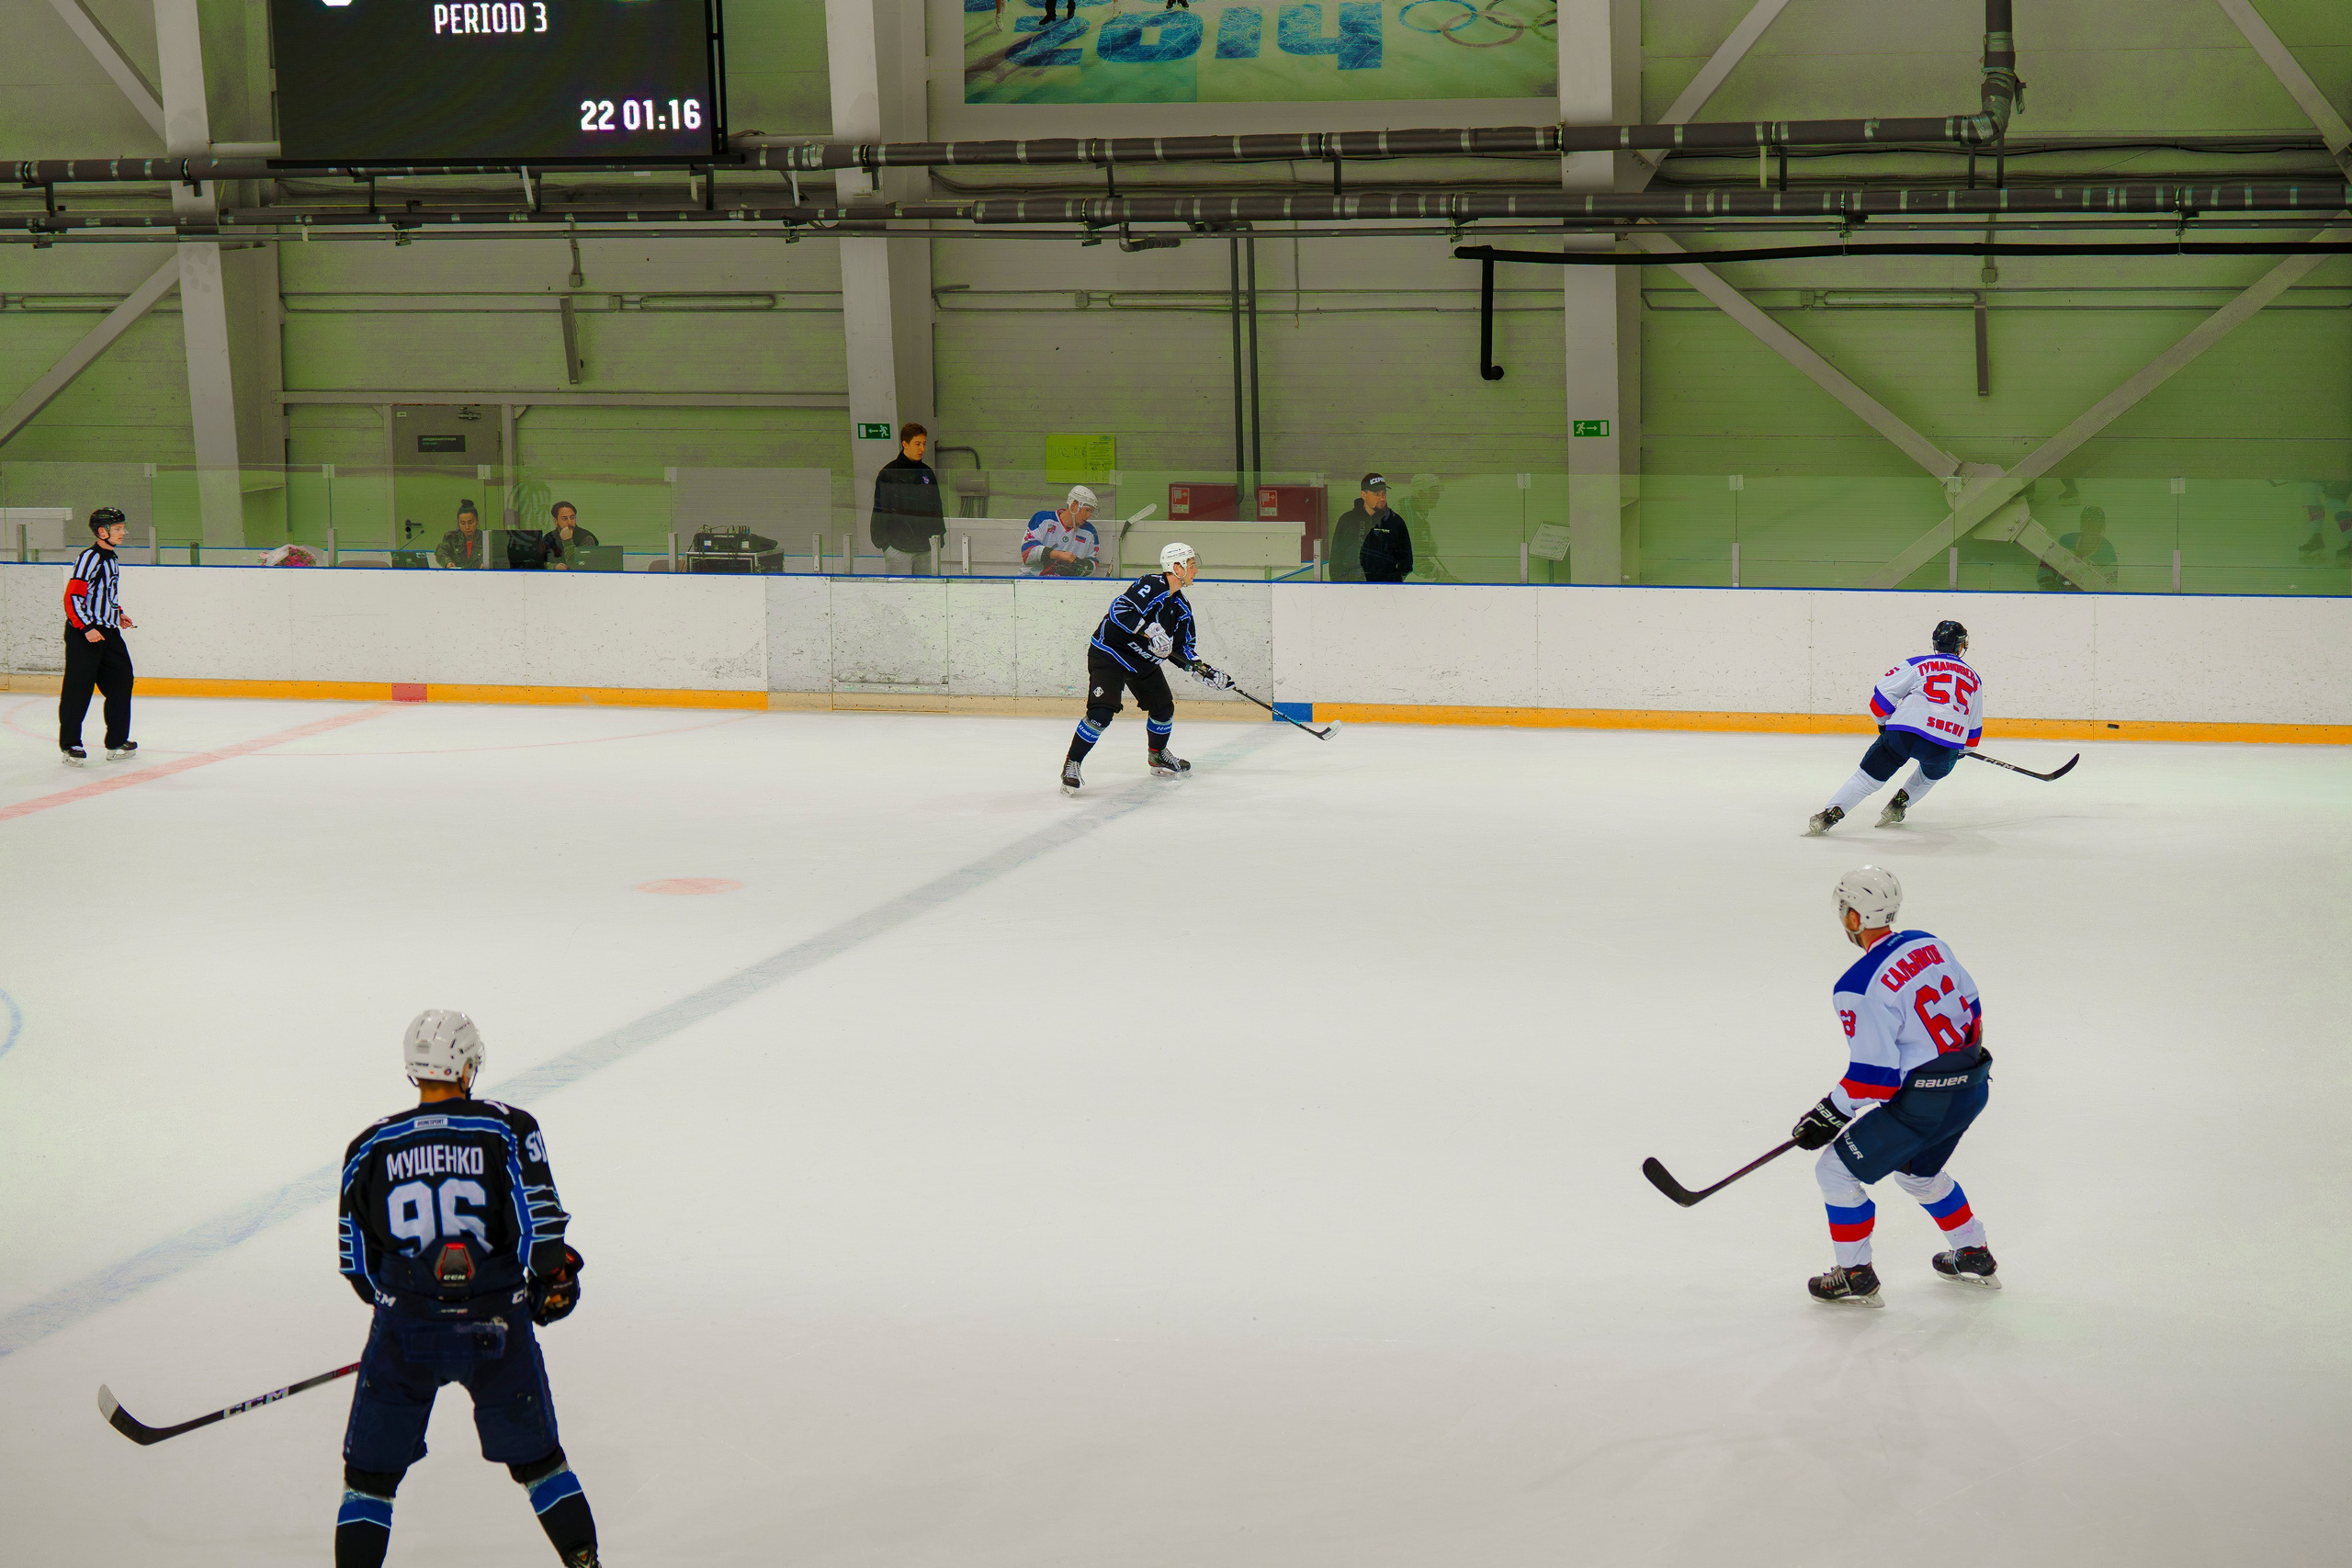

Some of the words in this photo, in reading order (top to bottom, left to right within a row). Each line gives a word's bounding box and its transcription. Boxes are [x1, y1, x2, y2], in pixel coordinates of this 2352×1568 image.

[434, 3, 526, 34] PERIOD
[534, 2, 548, 33] 3
[1004, 2, 1384, 70] 2014
[581, 100, 616, 130] 22
[623, 99, 701, 130] 01:16
[1137, 584, 1151, 598] 2
[1127, 641, 1152, 660] ONE
[1923, 672, 1974, 715] 55
[1927, 716, 1964, 737] SOCHI
[1984, 757, 2015, 771] CCM
[1914, 975, 1974, 1055] 63
[1914, 1075, 1969, 1088] BAUER
[1816, 1103, 1846, 1129] BAUE
[1843, 1132, 1864, 1160] AUER
[386, 1144, 485, 1182] МУЩЕНКО
[387, 1178, 494, 1258] 96
[223, 1387, 289, 1419] CCM
